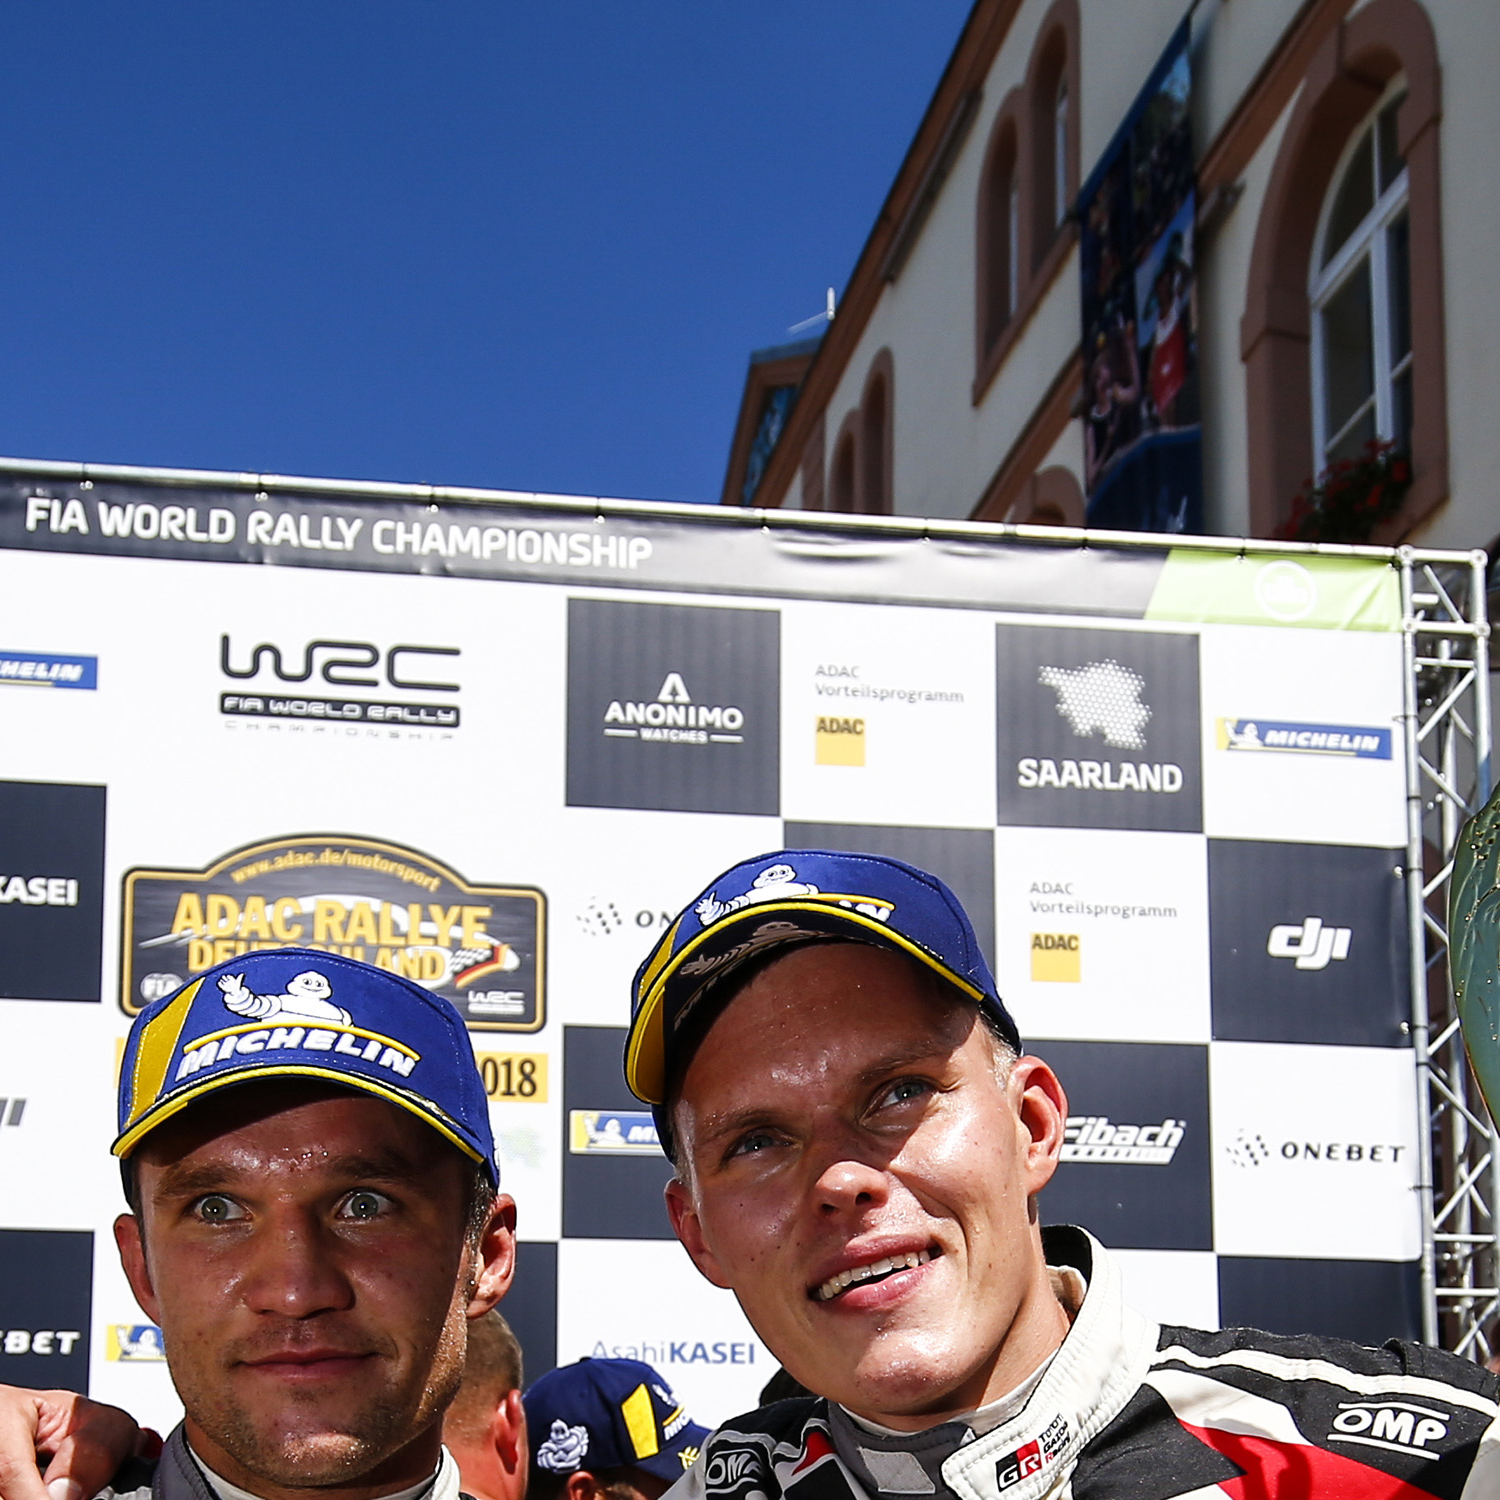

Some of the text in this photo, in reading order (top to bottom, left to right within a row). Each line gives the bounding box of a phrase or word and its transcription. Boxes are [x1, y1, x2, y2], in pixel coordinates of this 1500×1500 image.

[25, 497, 653, 569] FIA WORLD RALLY CHAMPIONSHIP
[221, 634, 461, 692] WRC
[815, 665, 860, 680] ADAC
[815, 683, 965, 705] Vorteilsprogramm
[223, 697, 457, 725] FIA WORLD RALLY
[604, 700, 744, 731] ANONIMO
[640, 728, 708, 745] WATCHES
[815, 716, 865, 736] ADAC
[1264, 730, 1381, 753] MICHELIN
[1017, 757, 1184, 794] SAARLAND
[231, 848, 442, 892] www.adac.de/motorsport
[1030, 882, 1074, 896] ADAC
[172, 892, 493, 949] ADAC RALLYE
[1030, 900, 1178, 919] Vorteilsprogramm
[1032, 935, 1079, 951] ADAC
[174, 1026, 421, 1082] MICHELIN
[1281, 1142, 1405, 1163] ONEBET
[590, 1340, 756, 1365] AsahiKASEI
[1333, 1408, 1449, 1448] OMP
[998, 1453, 1041, 1489] GR
